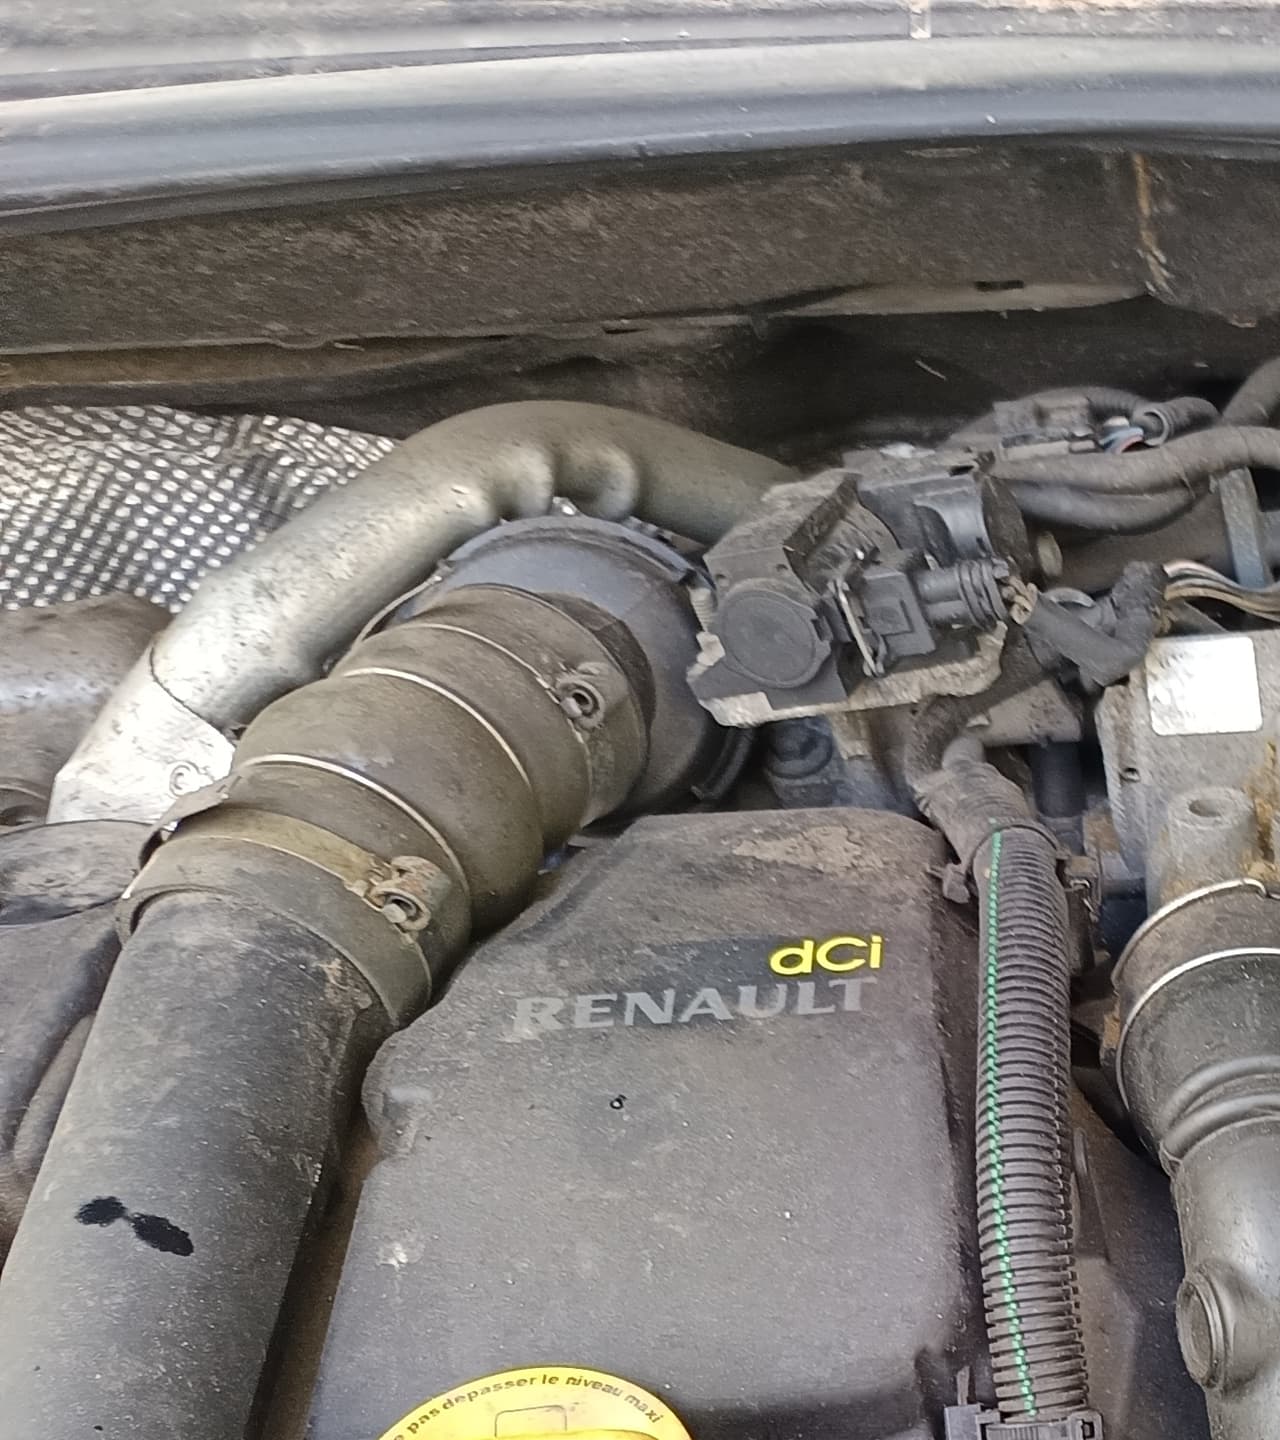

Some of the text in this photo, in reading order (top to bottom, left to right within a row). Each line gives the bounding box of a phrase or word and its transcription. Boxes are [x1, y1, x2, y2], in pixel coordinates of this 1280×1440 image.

[770, 935, 882, 975] dCi
[513, 977, 877, 1032] RENAULT
[406, 1408, 441, 1434] pas
[542, 1373, 559, 1386] le
[565, 1376, 624, 1397] niveau
[623, 1393, 664, 1424] maxi
